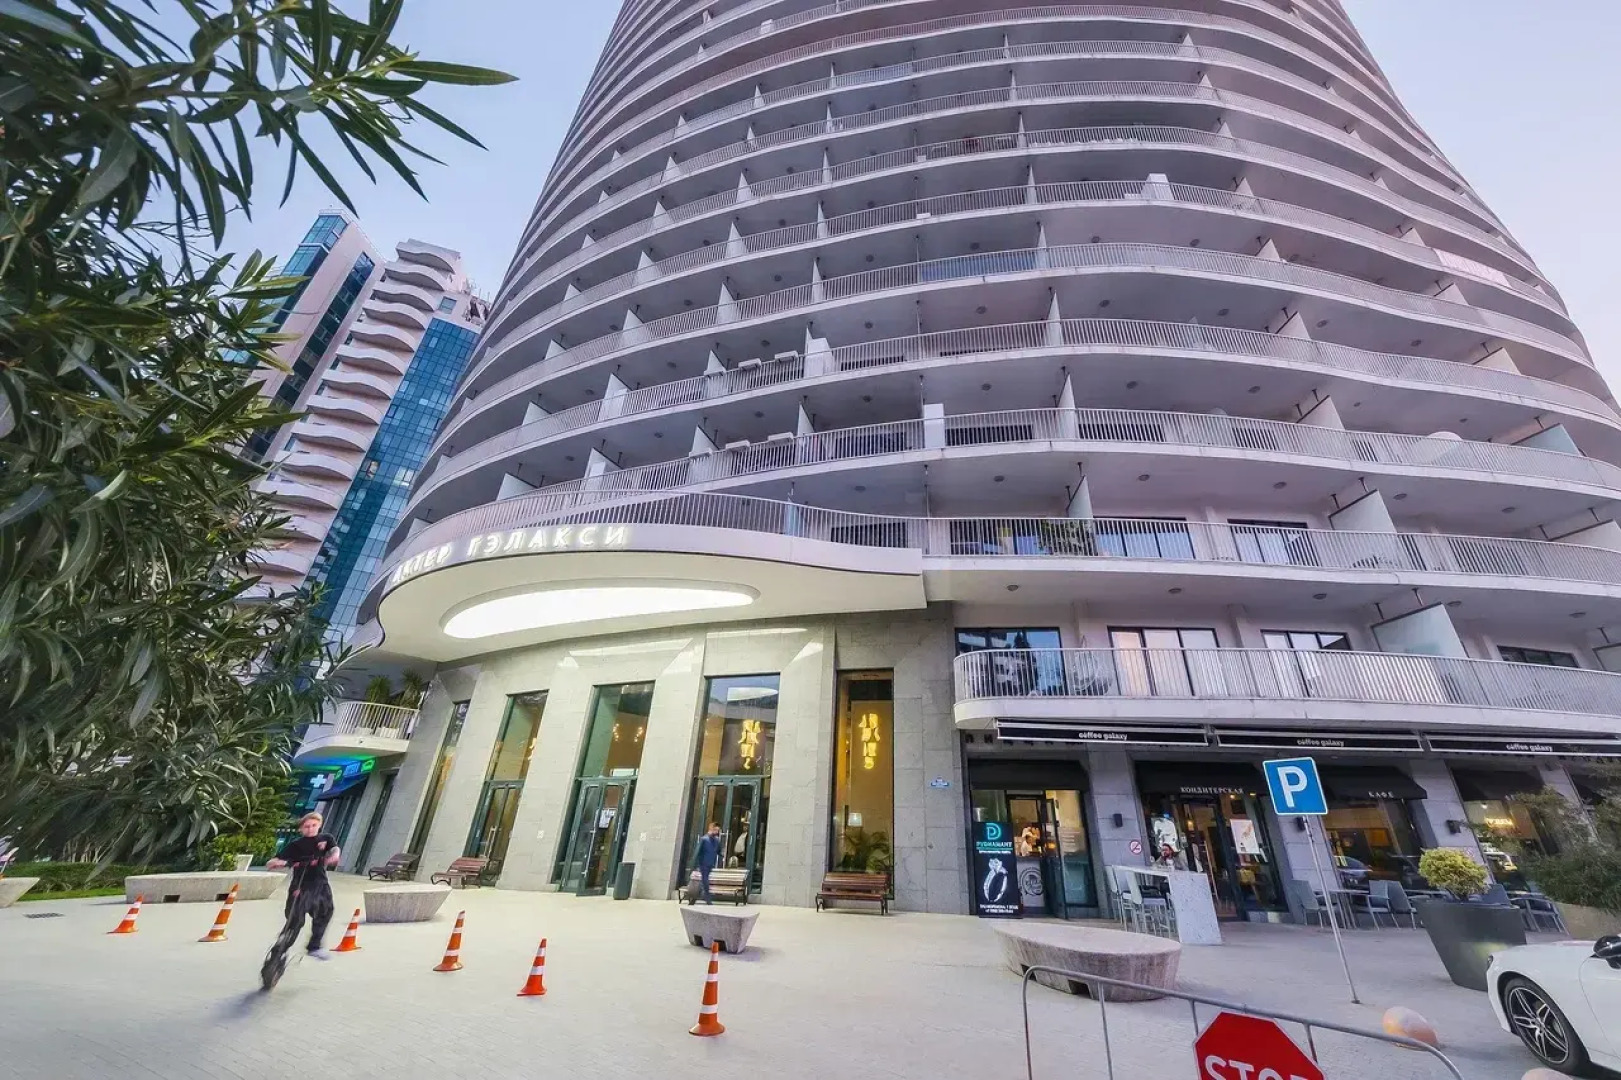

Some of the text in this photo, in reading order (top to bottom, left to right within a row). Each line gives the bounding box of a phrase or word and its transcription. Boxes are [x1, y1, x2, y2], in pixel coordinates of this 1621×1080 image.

[392, 525, 625, 583] АКТЕР ГЭЛАКСИ
[1103, 733, 1127, 741] galaxy
[1180, 787, 1244, 795] КОНДИТЕРСКАЯ
[1277, 766, 1307, 807] P
